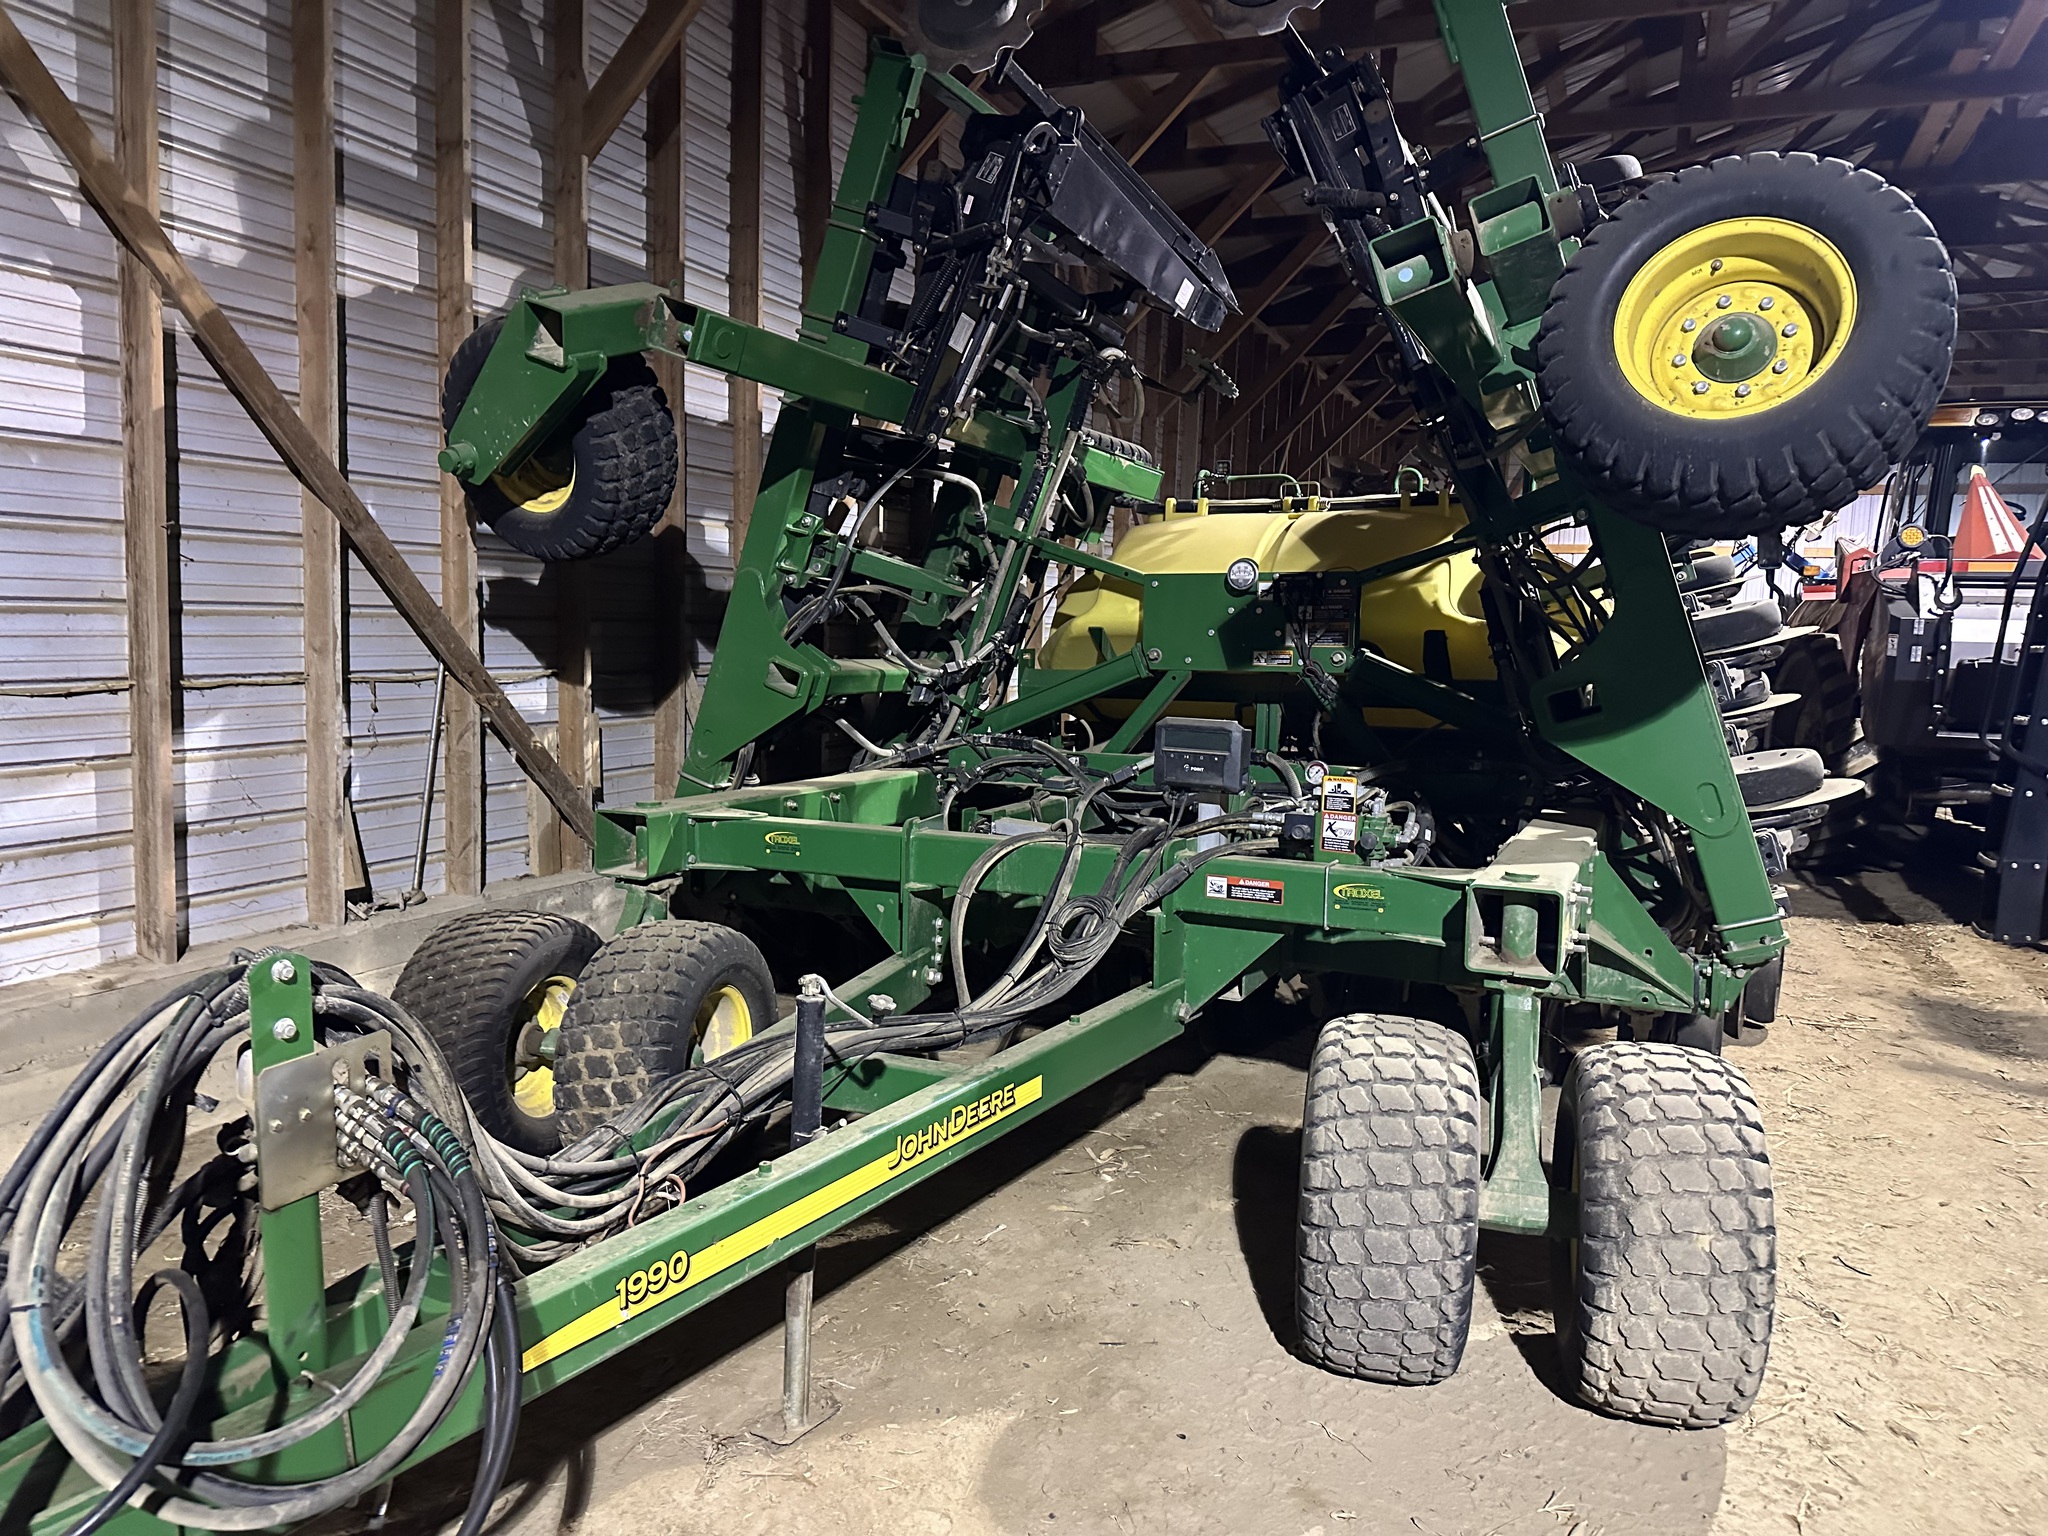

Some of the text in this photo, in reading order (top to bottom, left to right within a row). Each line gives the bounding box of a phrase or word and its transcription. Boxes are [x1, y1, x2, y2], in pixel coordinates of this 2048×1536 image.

[1329, 814, 1357, 822] DANGER
[1244, 879, 1270, 888] DANGER
[888, 1082, 1016, 1170] JOHN DEERE
[615, 1248, 692, 1311] 1990
